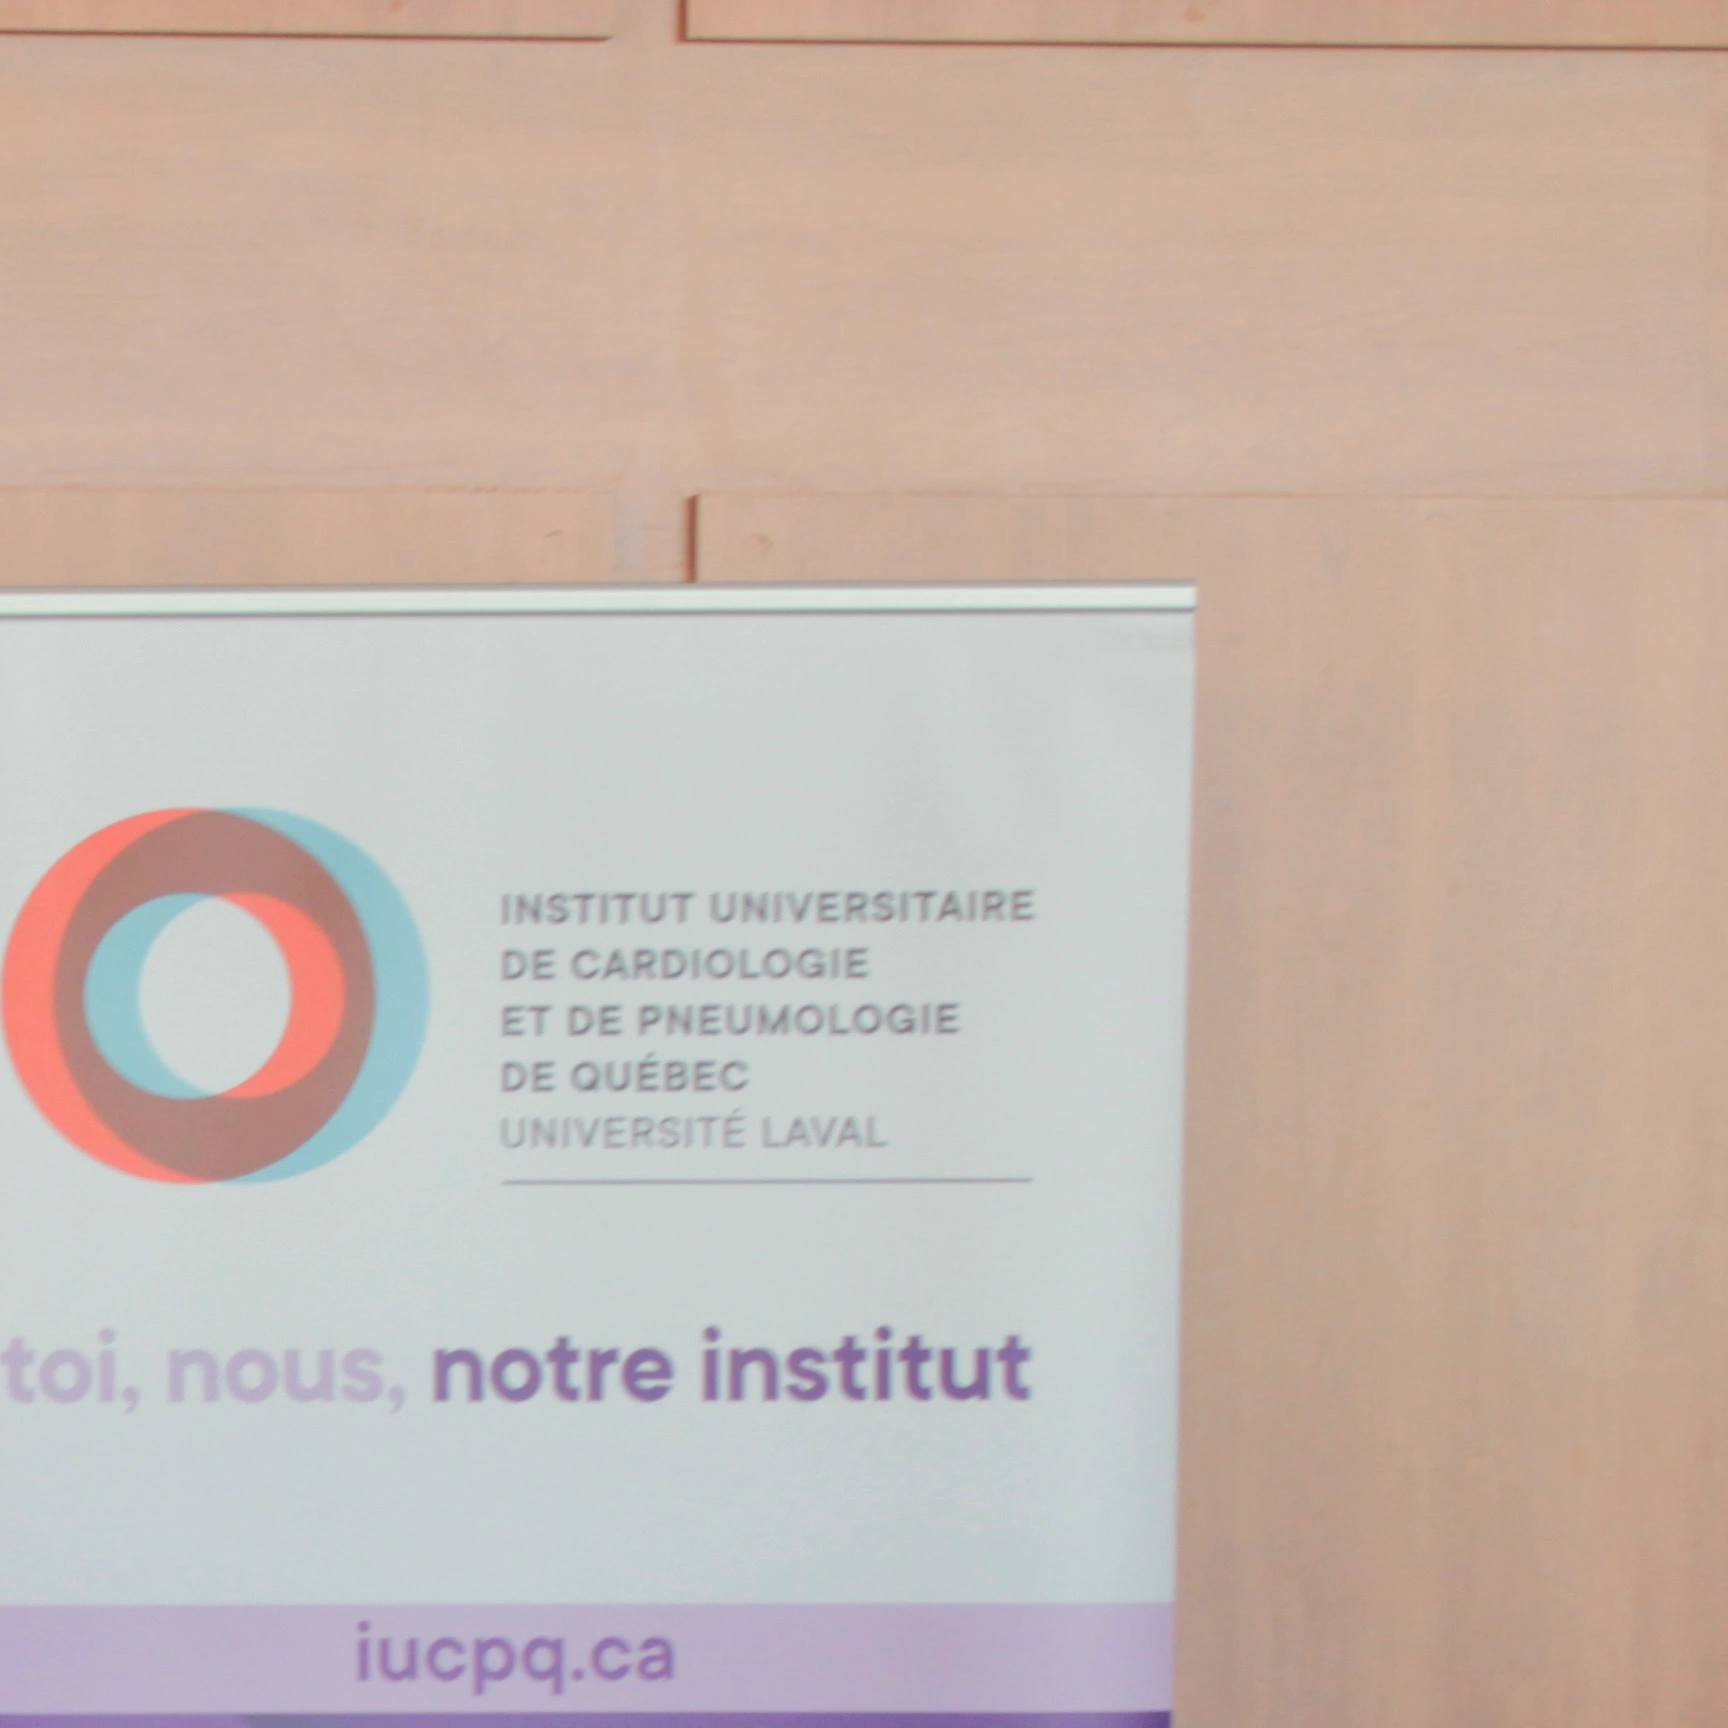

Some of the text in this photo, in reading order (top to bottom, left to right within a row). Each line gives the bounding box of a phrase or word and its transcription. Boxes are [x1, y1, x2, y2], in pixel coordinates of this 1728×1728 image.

[501, 889, 1034, 925] INSTITUT UNIVERSITAIRE
[501, 947, 870, 982] DE CARDIOLOGIE
[501, 1002, 960, 1037] ET DE PNEUMOLOGIE
[501, 1052, 750, 1094] DE QUÉBEC
[500, 1106, 890, 1150] UNIVERSITÉ LAVAL
[0, 1325, 1032, 1415] toi, nous, notre institut
[357, 1620, 677, 1696] iucpq.ca
